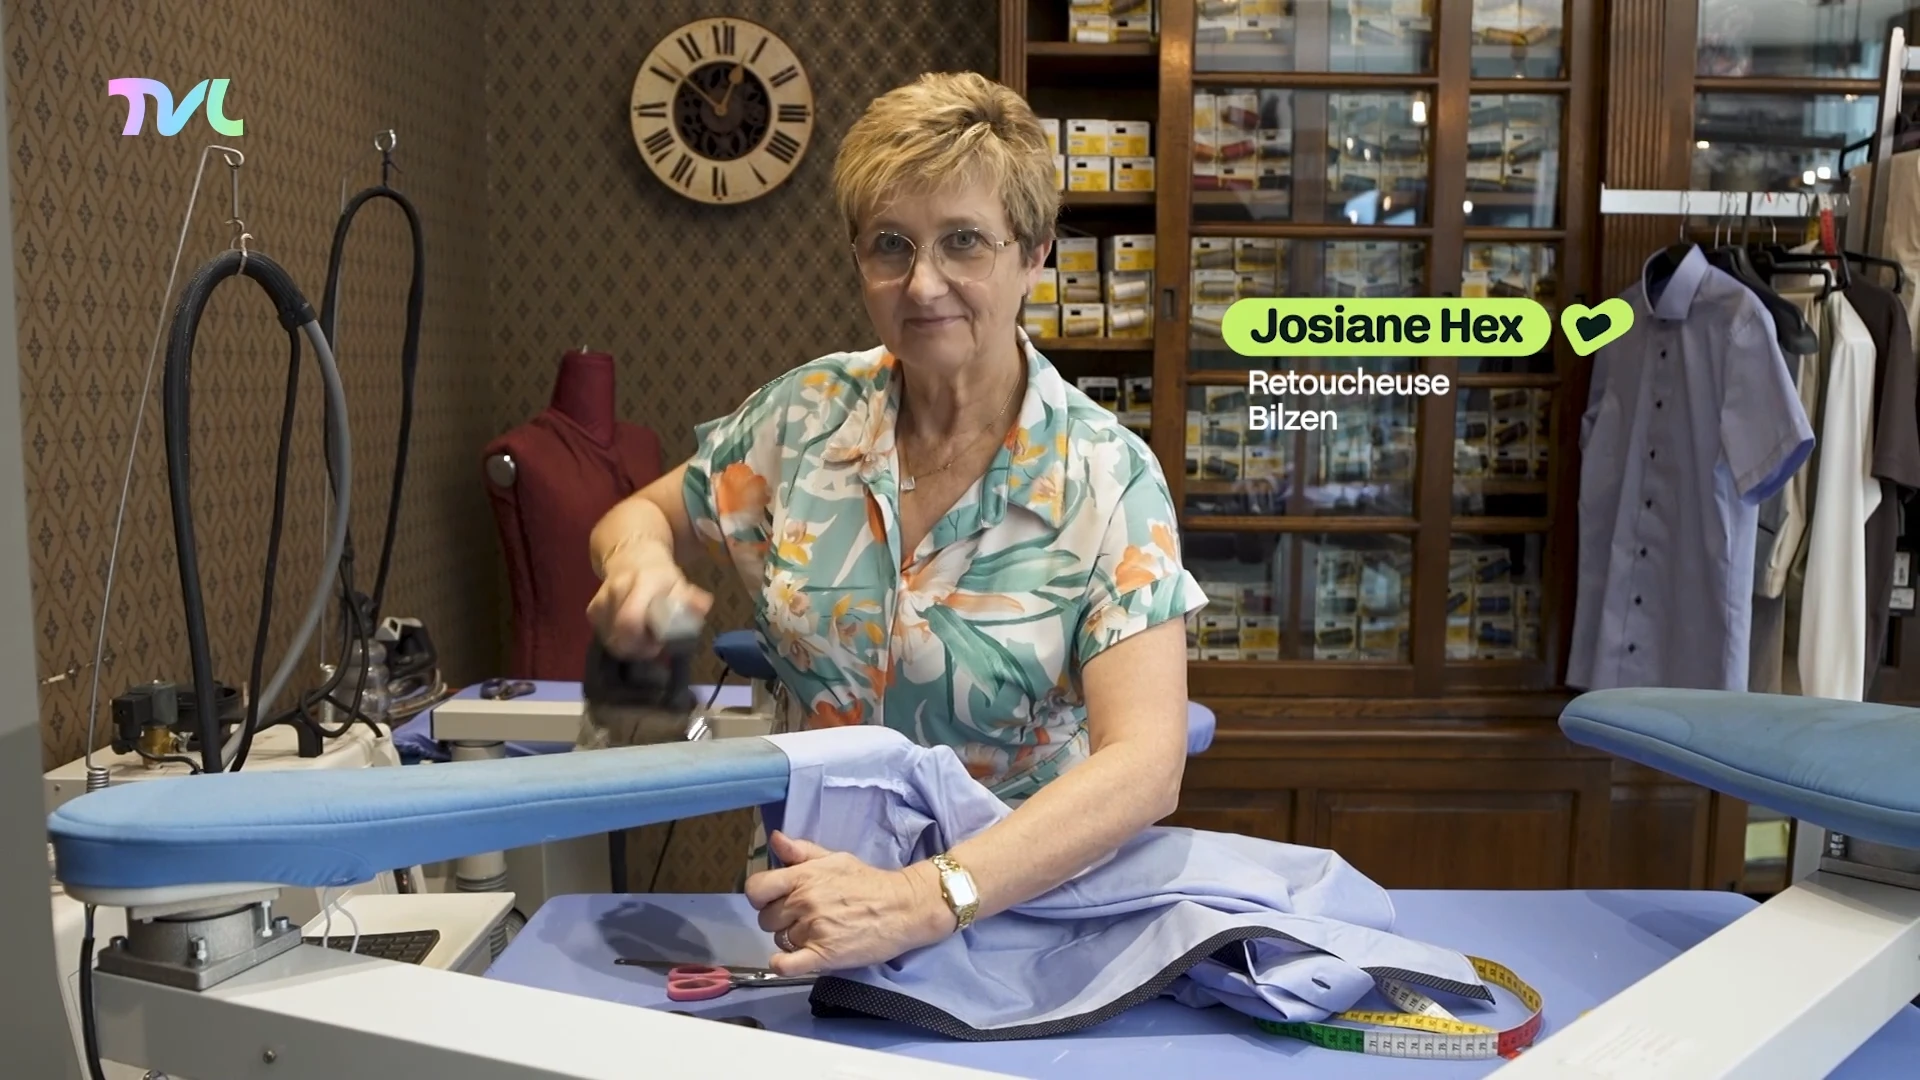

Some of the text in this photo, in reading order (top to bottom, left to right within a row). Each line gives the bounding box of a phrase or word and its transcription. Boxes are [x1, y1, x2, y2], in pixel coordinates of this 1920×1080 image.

[1383, 1041, 1391, 1049] 72
[1397, 1041, 1405, 1049] 73
[1452, 1043, 1460, 1051] 77
